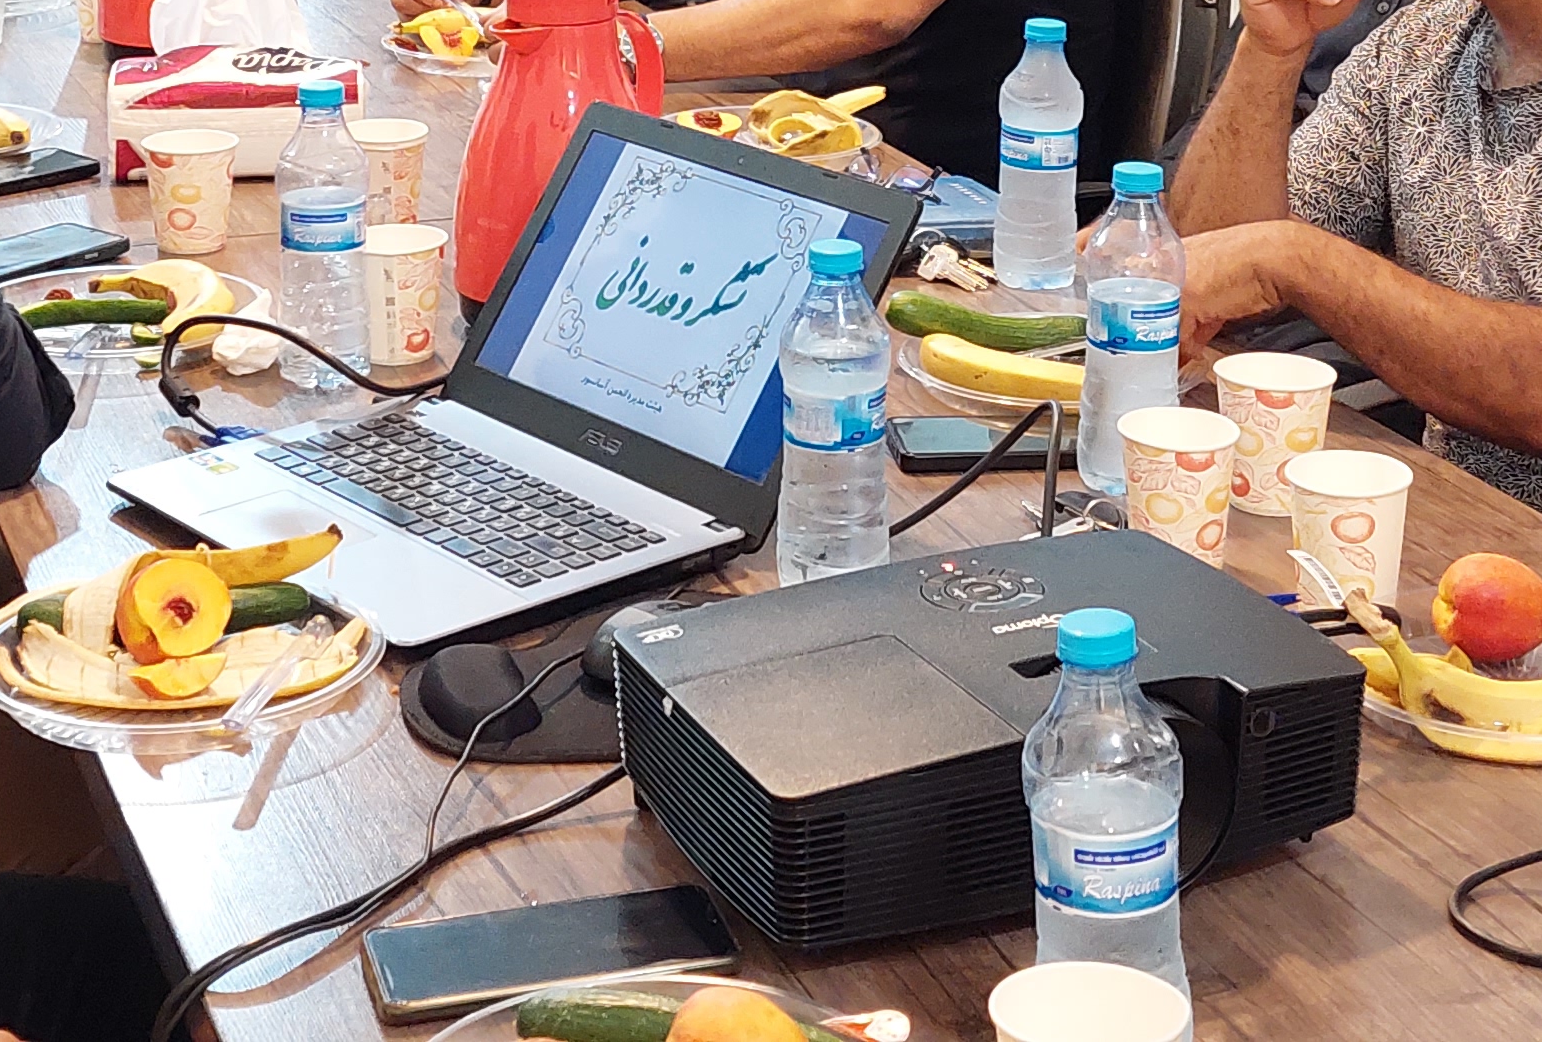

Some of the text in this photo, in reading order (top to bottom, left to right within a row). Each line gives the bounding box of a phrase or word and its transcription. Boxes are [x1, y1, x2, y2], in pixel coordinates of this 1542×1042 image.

[595, 234, 695, 316] قدردانی
[683, 252, 779, 327] تشکر
[1083, 875, 1161, 904] Raspina
